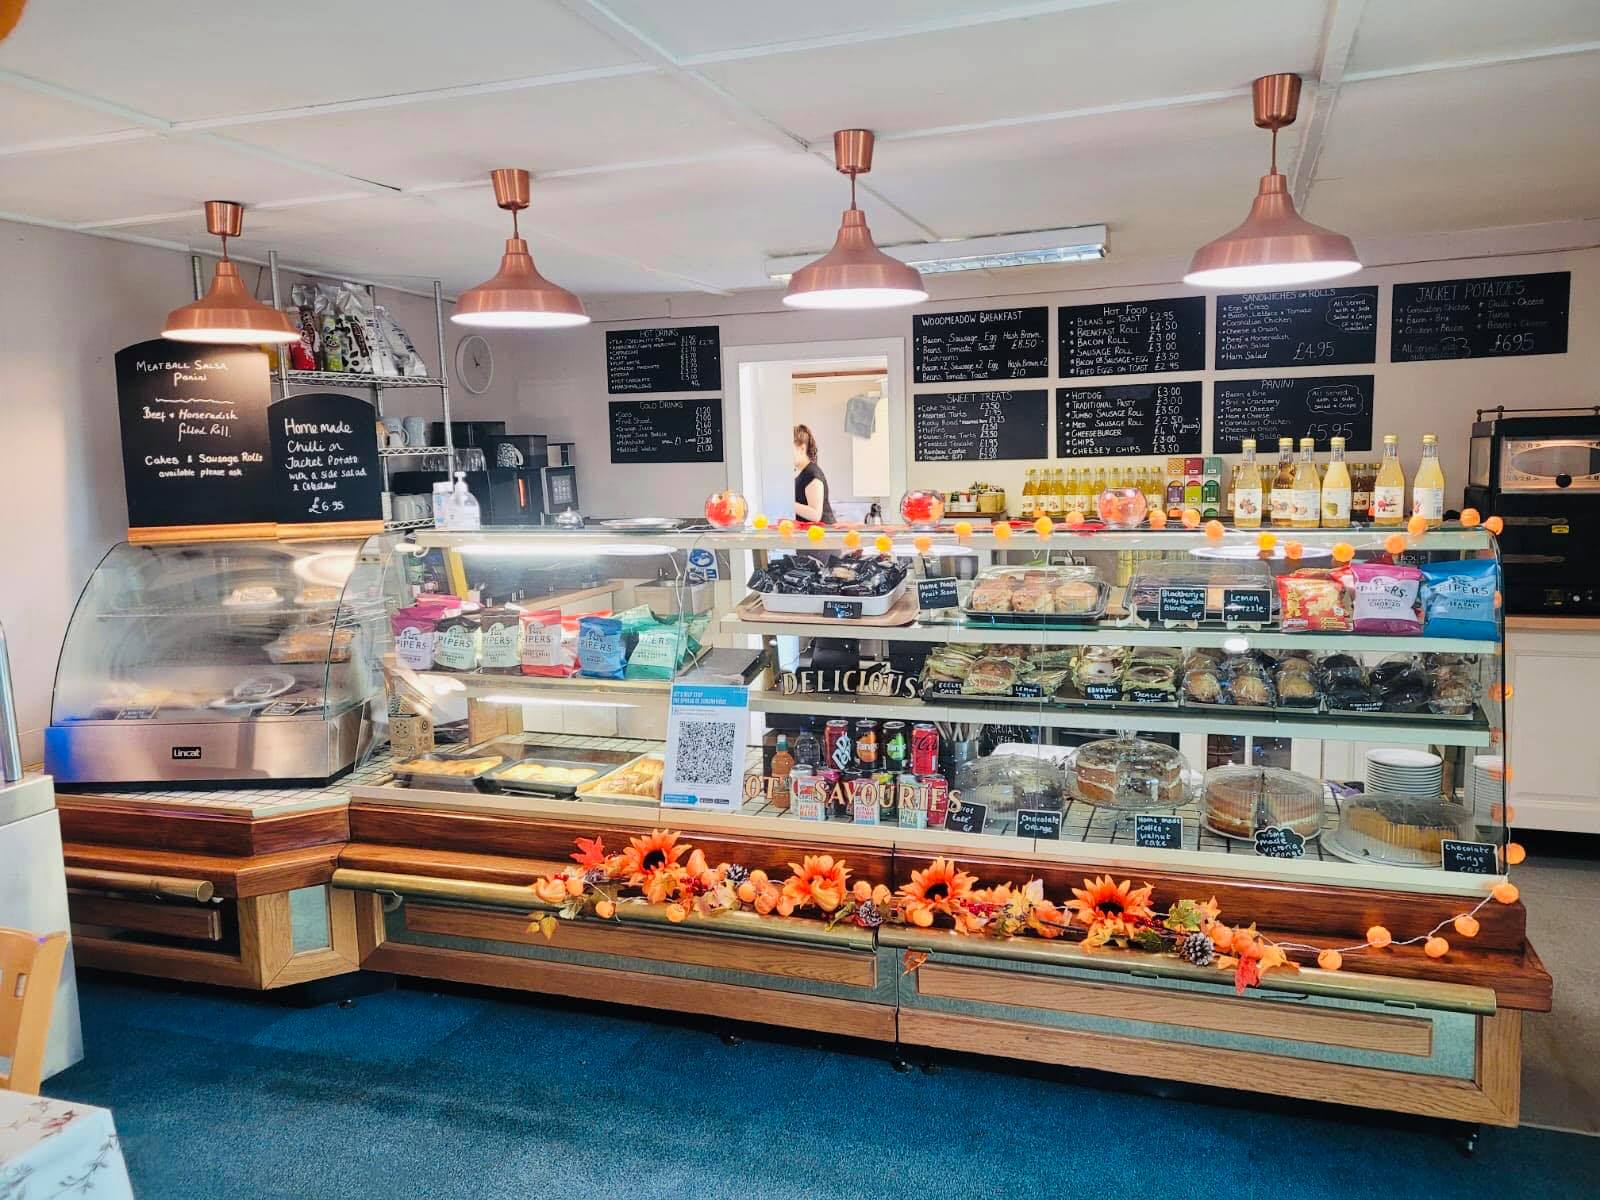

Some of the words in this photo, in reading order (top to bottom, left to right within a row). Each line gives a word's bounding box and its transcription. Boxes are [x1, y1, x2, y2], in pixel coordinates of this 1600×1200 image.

[1416, 286, 1457, 302] JACKET
[980, 311, 1023, 323] BREAKFAST
[136, 361, 190, 372] MEATBALL
[194, 360, 228, 370] SALSA
[174, 372, 207, 386] Panini
[1262, 380, 1294, 389] PANINI
[143, 407, 166, 422] Beef
[1096, 409, 1126, 418] SAUSAGE
[1095, 420, 1126, 428] SAUSAGE
[288, 440, 326, 453] Chilli
[1072, 447, 1110, 455] CHEESEY
[145, 456, 179, 465] Cakes
[199, 454, 239, 466] Sausage
[241, 452, 263, 462] Rolls
[285, 456, 323, 469] Jacket
[328, 455, 358, 465] Potato
[159, 469, 195, 477] available
[200, 468, 225, 478] please
[321, 470, 338, 478] side
[341, 468, 367, 477] salad
[1162, 590, 1199, 600] Blackberry
[1231, 594, 1259, 602] Lemon
[439, 636, 471, 648] PIPERS
[783, 669, 919, 699] DELICIOUS
[174, 749, 200, 757] Lincat
[814, 780, 962, 813] SAVOURIES
[1020, 815, 1059, 824] Chocolate
[1025, 824, 1052, 833] Orange
